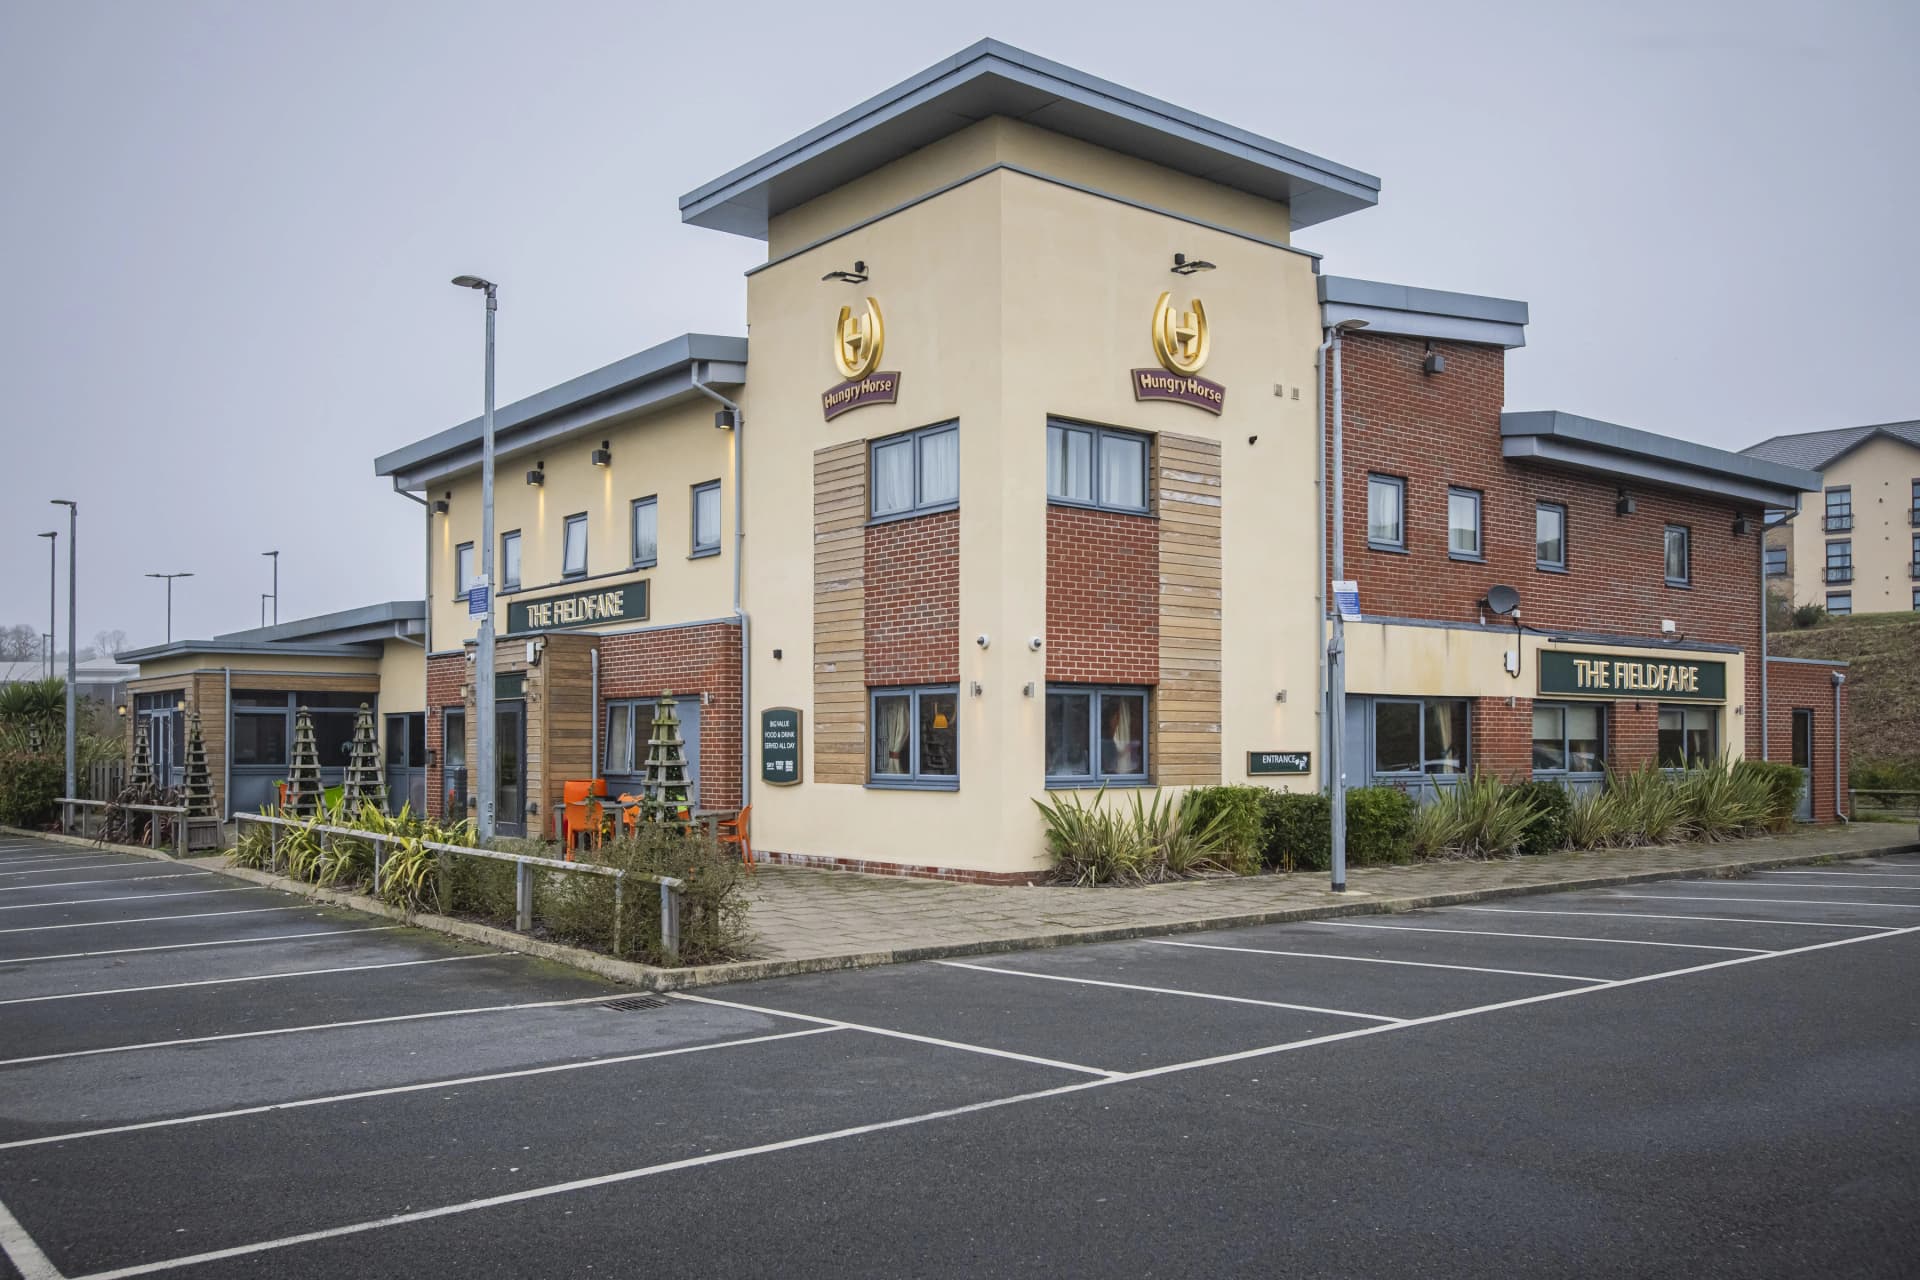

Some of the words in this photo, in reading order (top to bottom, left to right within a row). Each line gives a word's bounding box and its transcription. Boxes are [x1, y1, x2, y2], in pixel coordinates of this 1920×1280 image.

[824, 384, 860, 409] Hungry
[861, 378, 893, 394] Horse
[1140, 374, 1187, 394] Hungry
[1187, 378, 1222, 403] Horse
[526, 602, 552, 629] THE
[553, 590, 624, 625] FIELDFARE
[1573, 659, 1610, 688] THE
[1614, 661, 1699, 692] FIELDFARE
[1262, 754, 1296, 764] ENTRANCE
